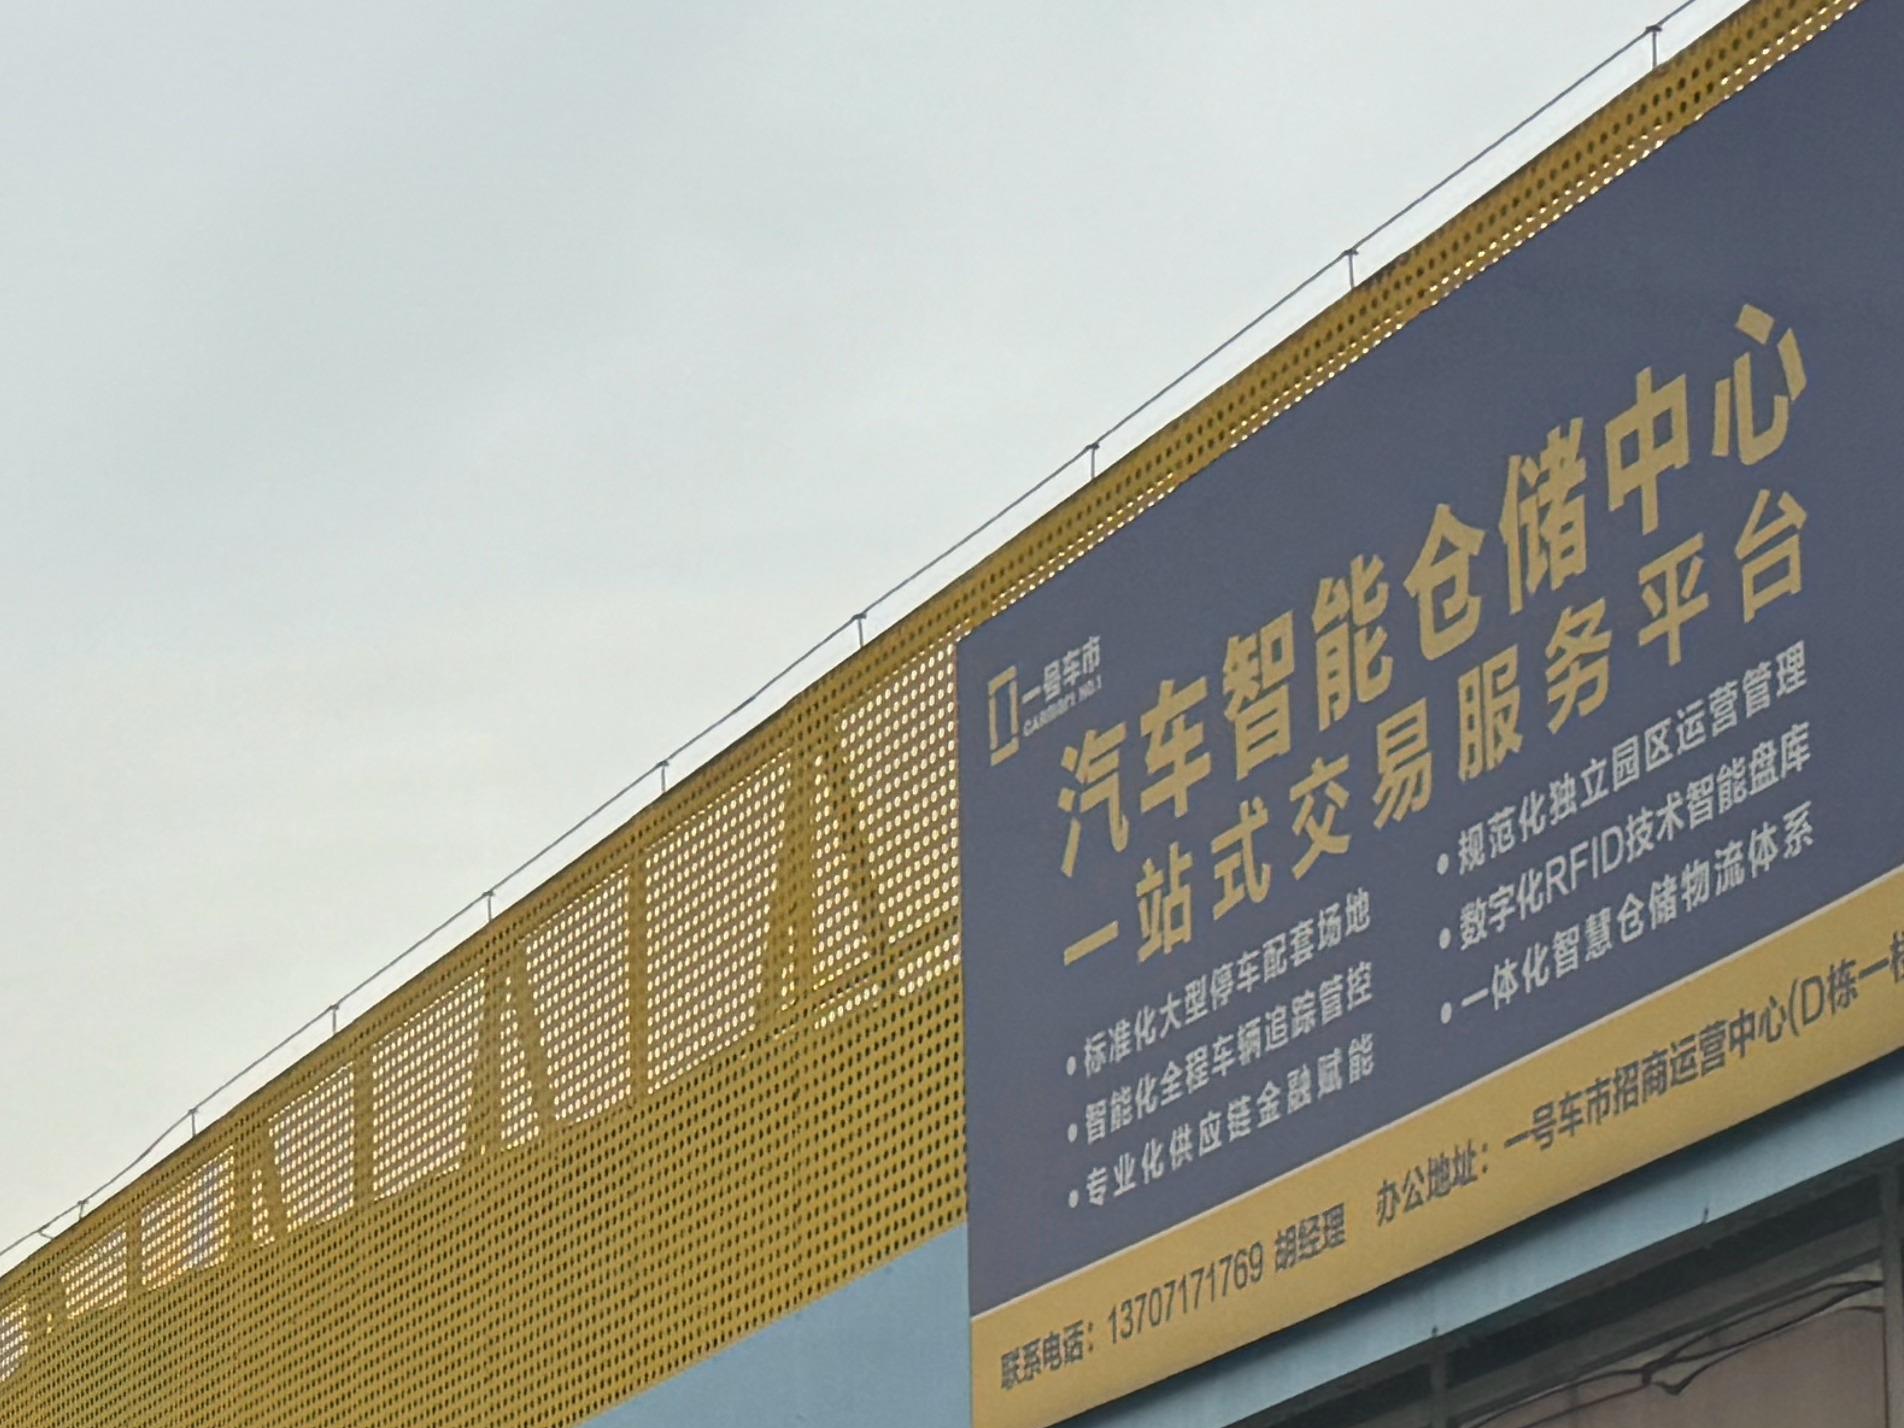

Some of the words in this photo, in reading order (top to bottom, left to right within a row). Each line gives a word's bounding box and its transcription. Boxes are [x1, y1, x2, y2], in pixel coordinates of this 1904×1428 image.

[1022, 635, 1101, 704] 一号车市
[1059, 303, 1808, 878] 汽车智能仓储中心
[1062, 488, 1809, 966] 一站式交易服务平台
[1458, 640, 1806, 876] 规范化独立园区运营管理
[1460, 720, 1811, 951] 数字化RFID技术智能盘库
[1461, 801, 1814, 1011] 一体化智慧仓储物流体系
[1084, 887, 1371, 1078] 标准化大型停车配套场地
[1085, 961, 1373, 1145] 智能化全程车辆追踪管控
[1086, 1033, 1375, 1206] 专业化供应链金融赋能
[1274, 1203, 1347, 1273] 胡经理
